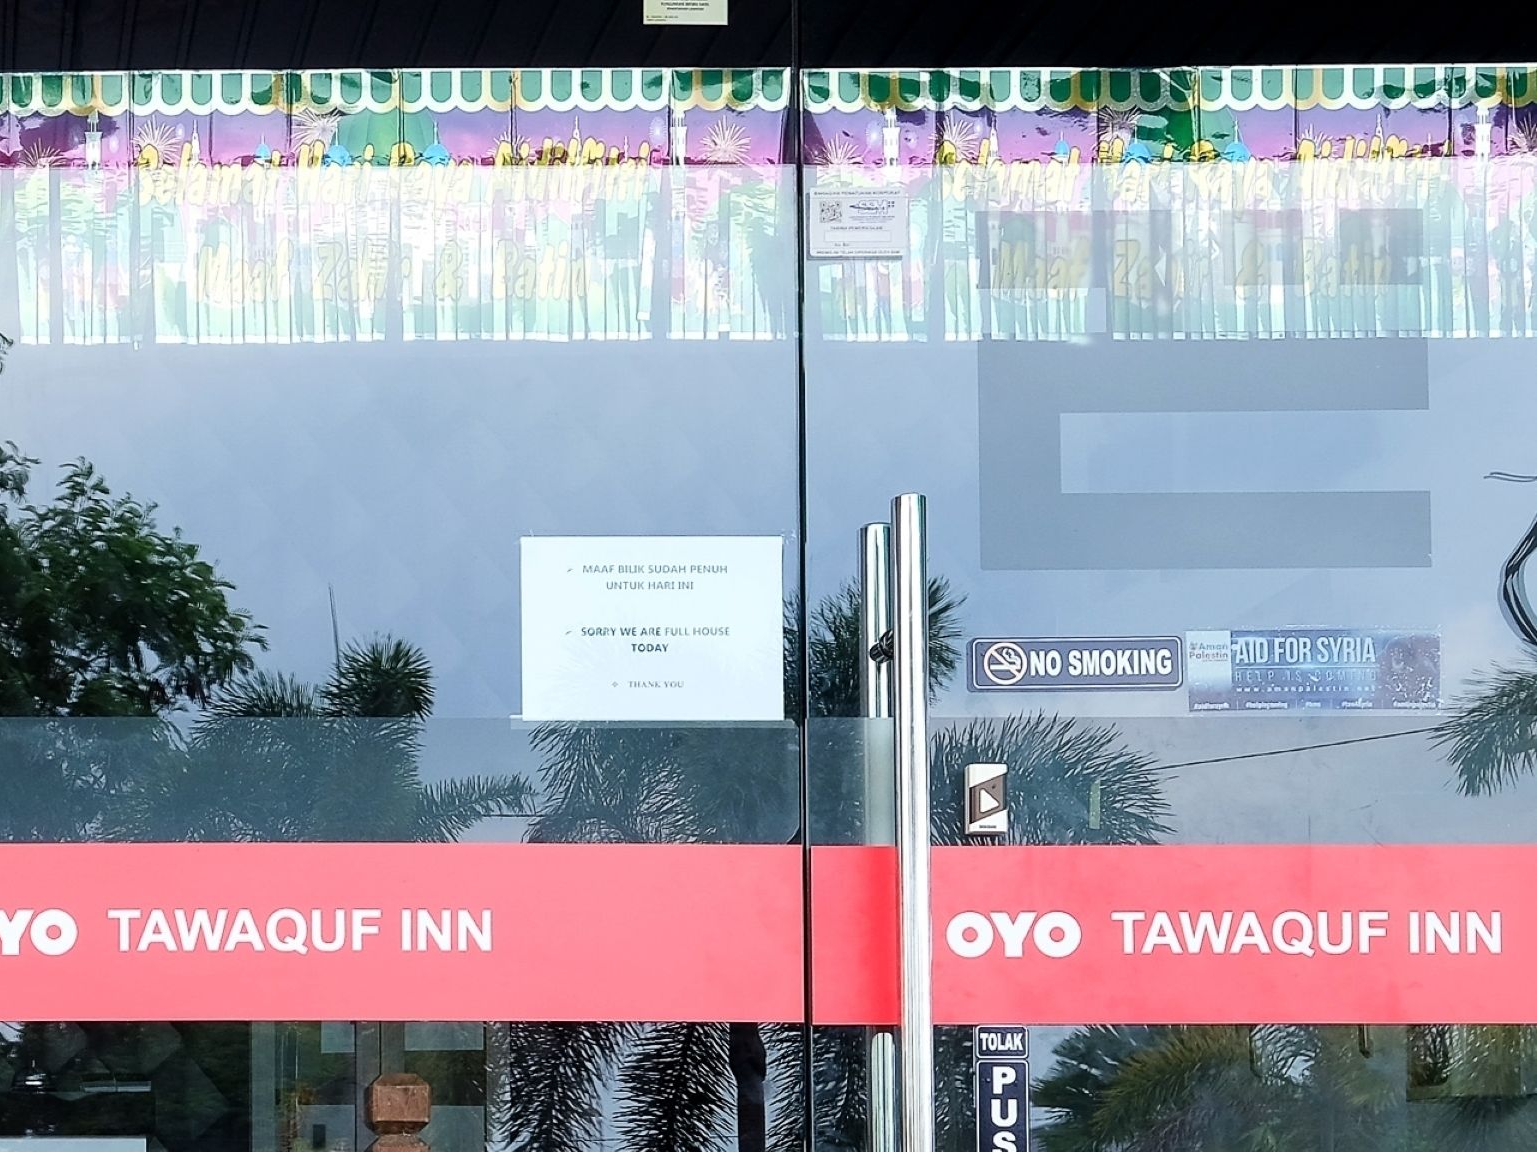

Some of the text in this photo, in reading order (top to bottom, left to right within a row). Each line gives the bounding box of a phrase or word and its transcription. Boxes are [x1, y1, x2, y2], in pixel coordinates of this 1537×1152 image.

[582, 565, 728, 574] MAAF BILIK SUDAH PENUH
[606, 581, 694, 590] UNTUK HARI INI
[581, 627, 731, 637] SORRY WE ARE FULL HOUSE
[632, 643, 670, 653] TODAY
[1234, 636, 1377, 664] AID FOR SYRIA
[1029, 648, 1173, 678] NO SMOKING
[628, 680, 684, 689] THANK YOU
[107, 907, 383, 955] TAWAQUF
[400, 907, 493, 952] INN
[945, 909, 1503, 959] OYO TAWAQUF INN
[979, 1033, 1024, 1051] TOLAK
